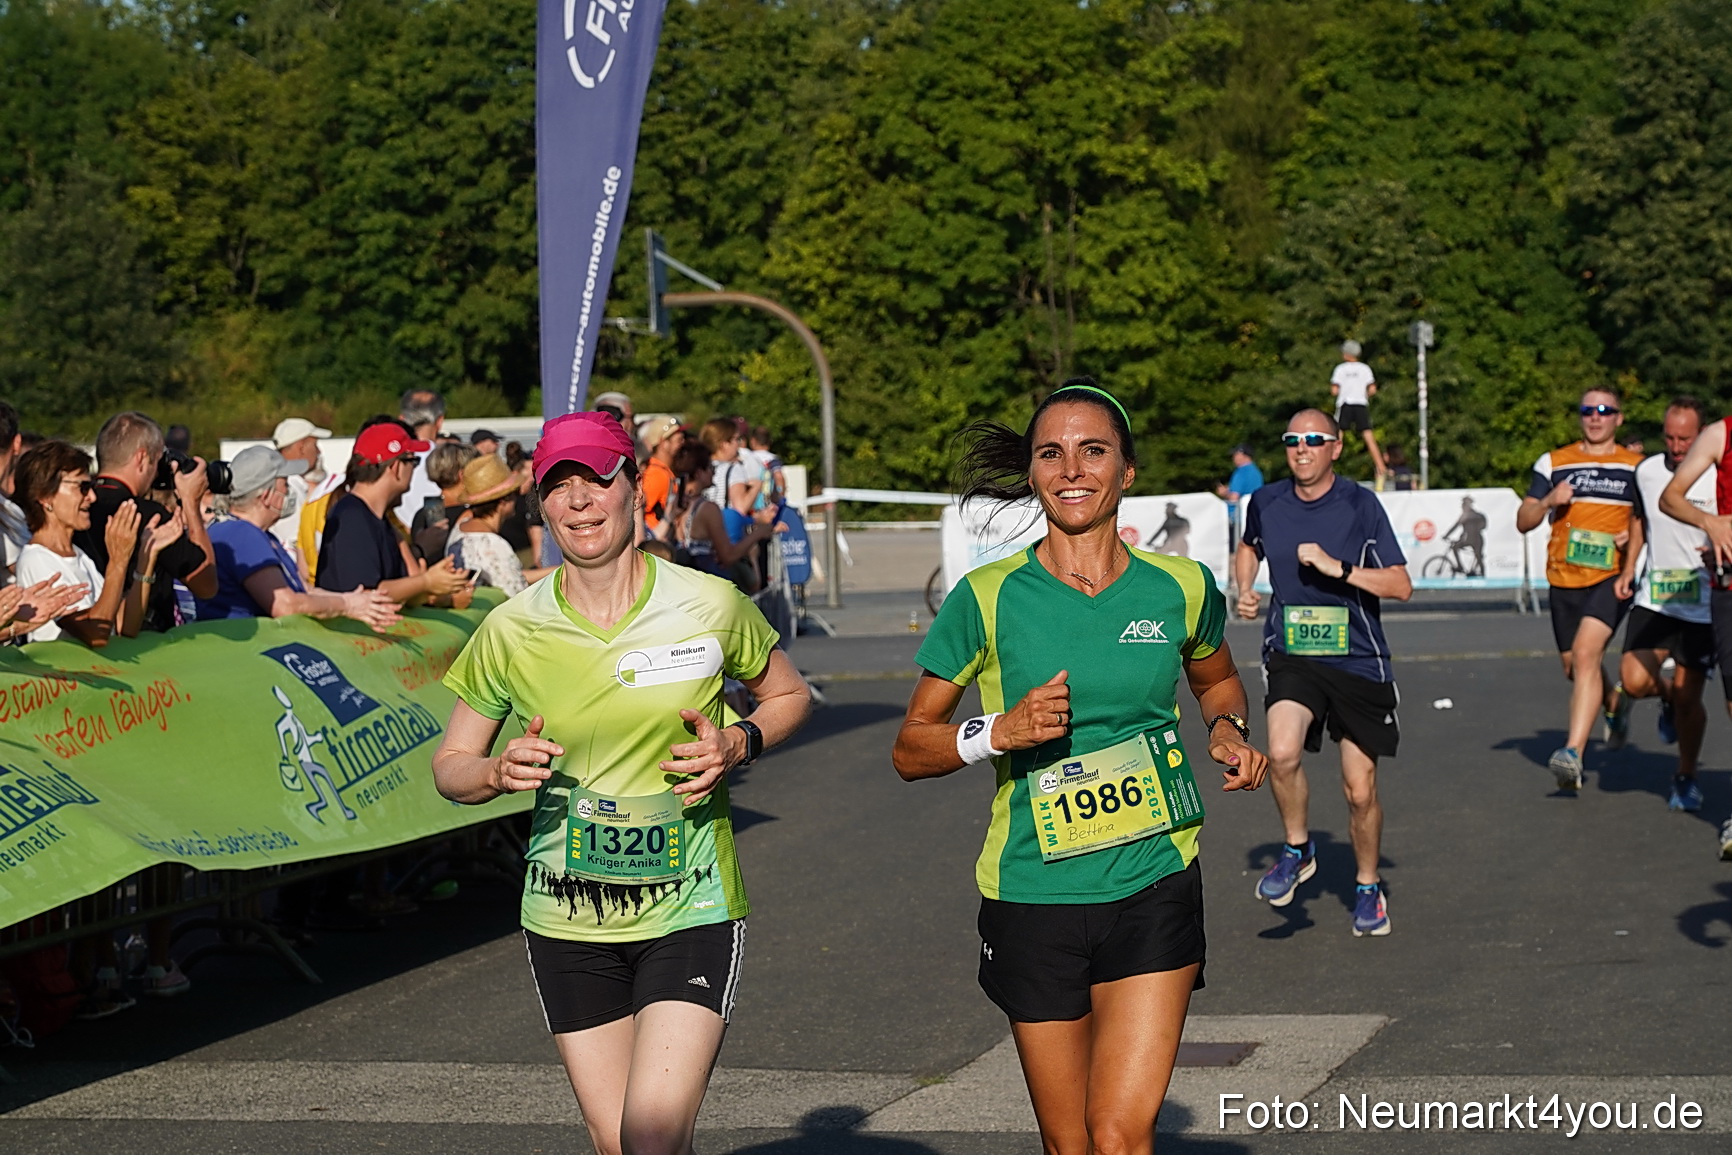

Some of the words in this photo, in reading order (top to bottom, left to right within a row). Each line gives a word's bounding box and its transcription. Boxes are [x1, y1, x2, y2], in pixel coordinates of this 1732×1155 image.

[1119, 619, 1168, 638] AOK
[1299, 623, 1332, 639] 962
[670, 646, 706, 657] Klinikum
[671, 654, 705, 664] Neumarkt
[355, 764, 409, 809] neumarkt
[1059, 768, 1099, 786] Firmenlauf
[1054, 775, 1143, 824] 1986
[1142, 774, 1162, 819] 2022
[593, 810, 631, 819] Firmenlauf
[1038, 800, 1059, 848] WALK
[584, 822, 666, 856] 1320
[1066, 823, 1115, 842] Bettina
[571, 827, 582, 860] RUN
[668, 826, 680, 868] 2022
[587, 854, 626, 869] Krüger
[628, 858, 662, 868] Anika
